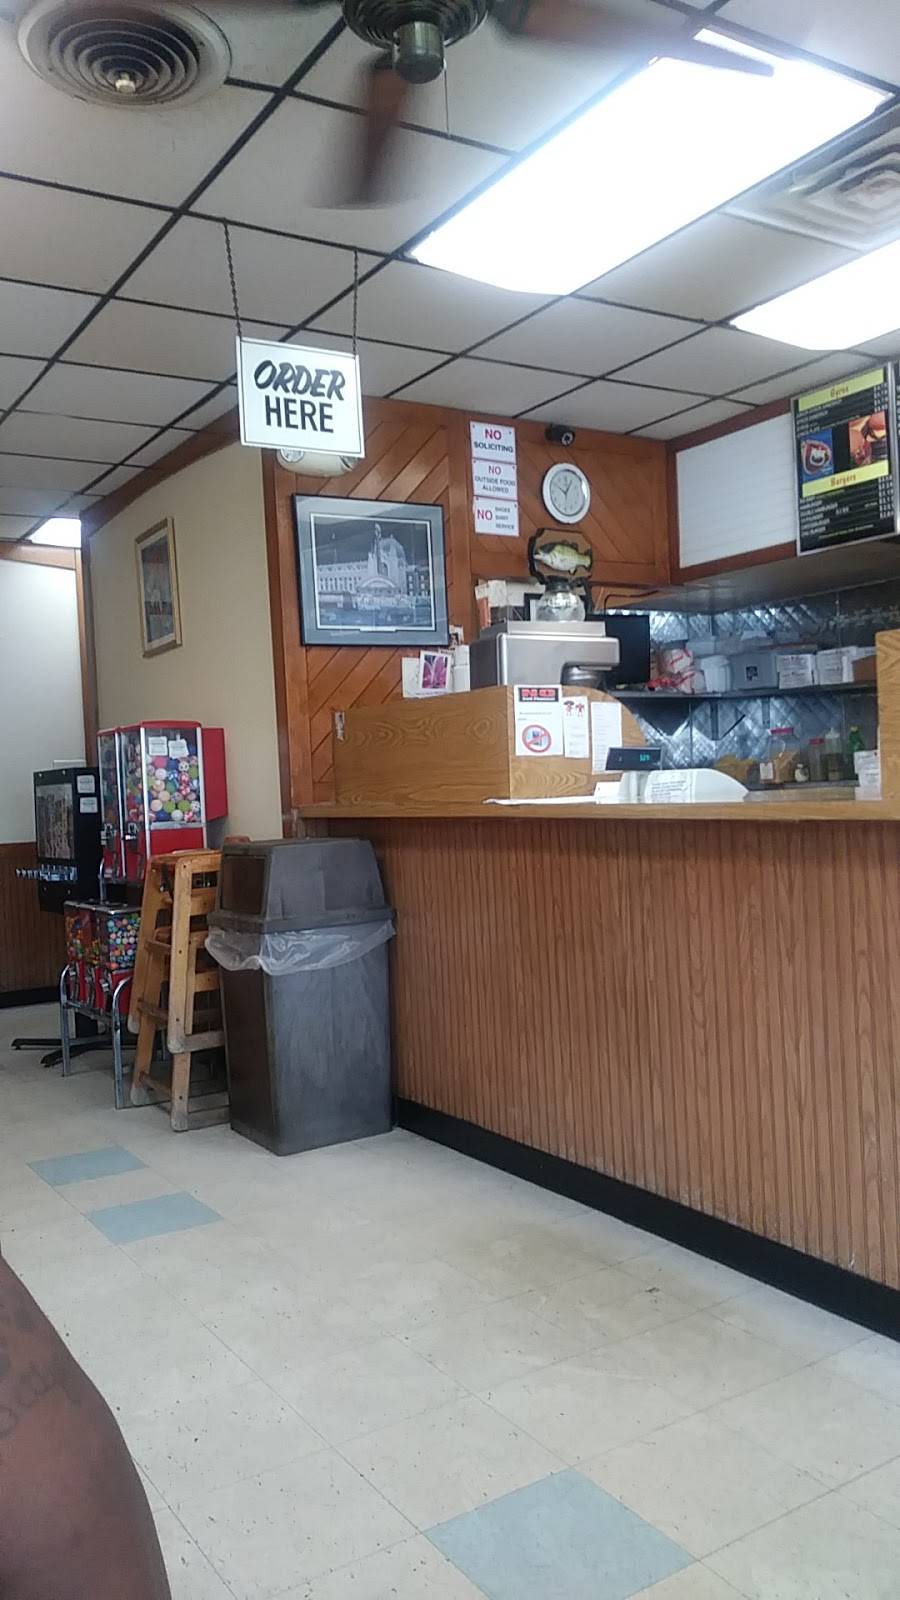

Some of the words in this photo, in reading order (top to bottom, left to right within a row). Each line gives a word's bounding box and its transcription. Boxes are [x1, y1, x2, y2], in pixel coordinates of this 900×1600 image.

[254, 360, 346, 401] ORDER
[264, 395, 334, 433] HERE
[484, 428, 502, 440] NO
[473, 441, 514, 453] SOLICITING
[488, 465, 502, 475] NO
[474, 475, 498, 485] OUTSIDE
[830, 474, 857, 487] Burgers
[482, 485, 509, 494] ALLOWED
[477, 508, 493, 521] NO
